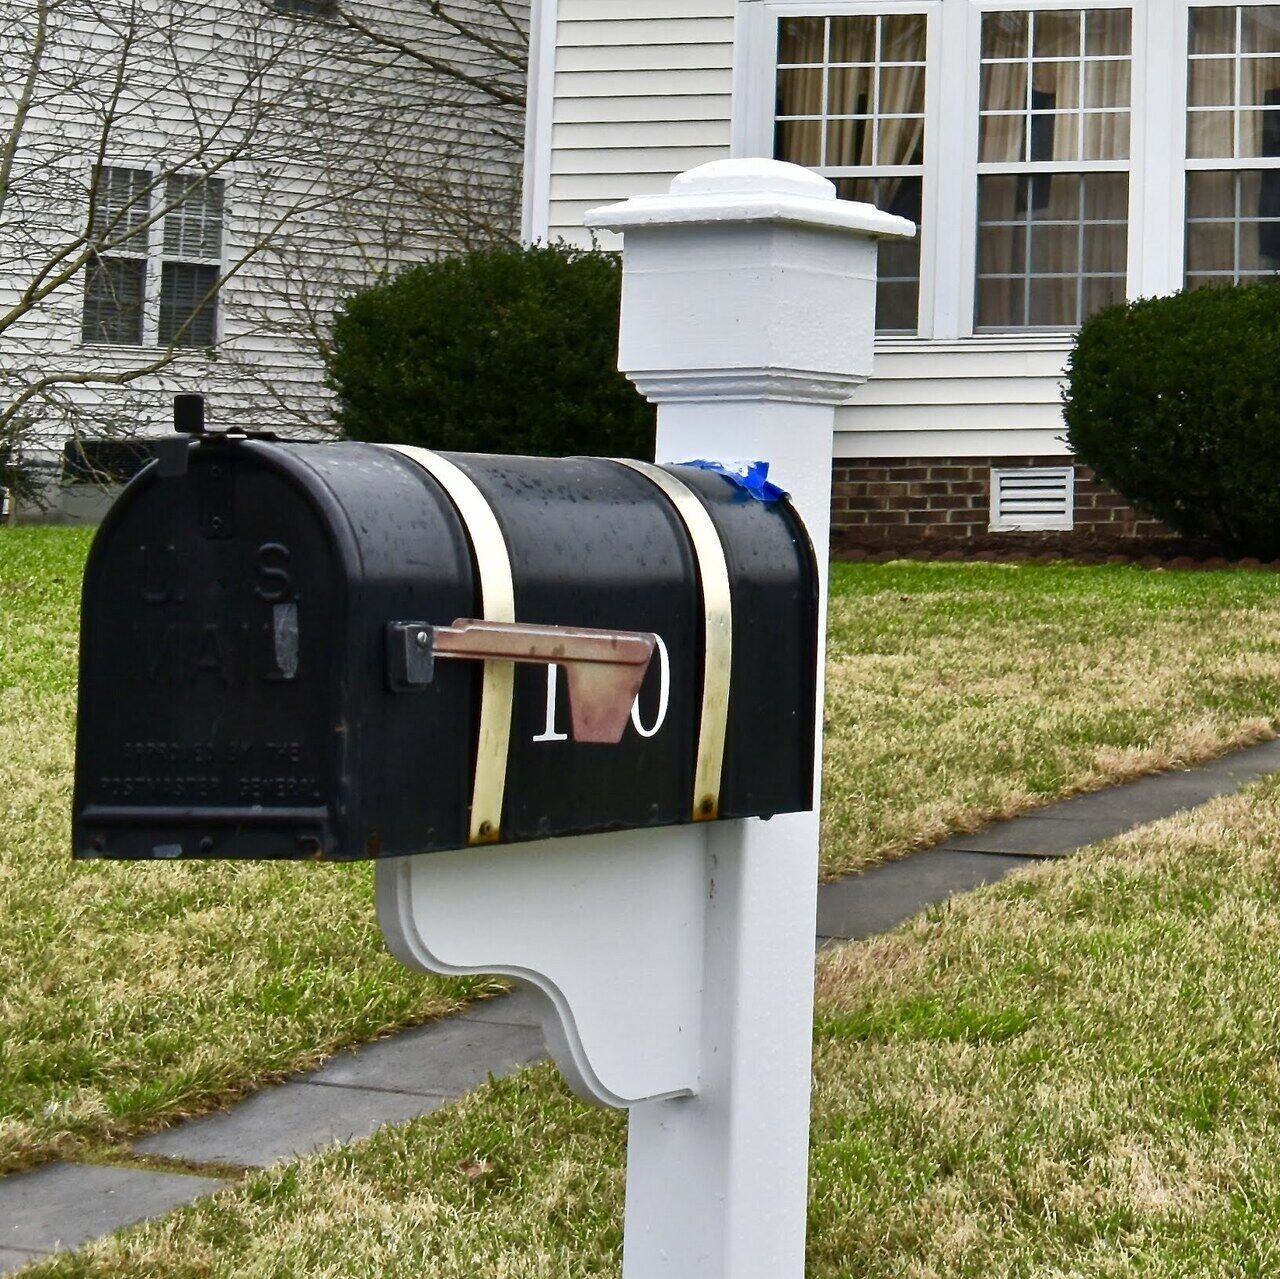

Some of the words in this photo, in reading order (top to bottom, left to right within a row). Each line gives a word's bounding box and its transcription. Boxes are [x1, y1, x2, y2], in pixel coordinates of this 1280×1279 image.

[532, 624, 671, 743] 10
[265, 740, 300, 763] THE
[99, 775, 220, 799] POSTMASTER
[239, 775, 321, 800] GENERAL
